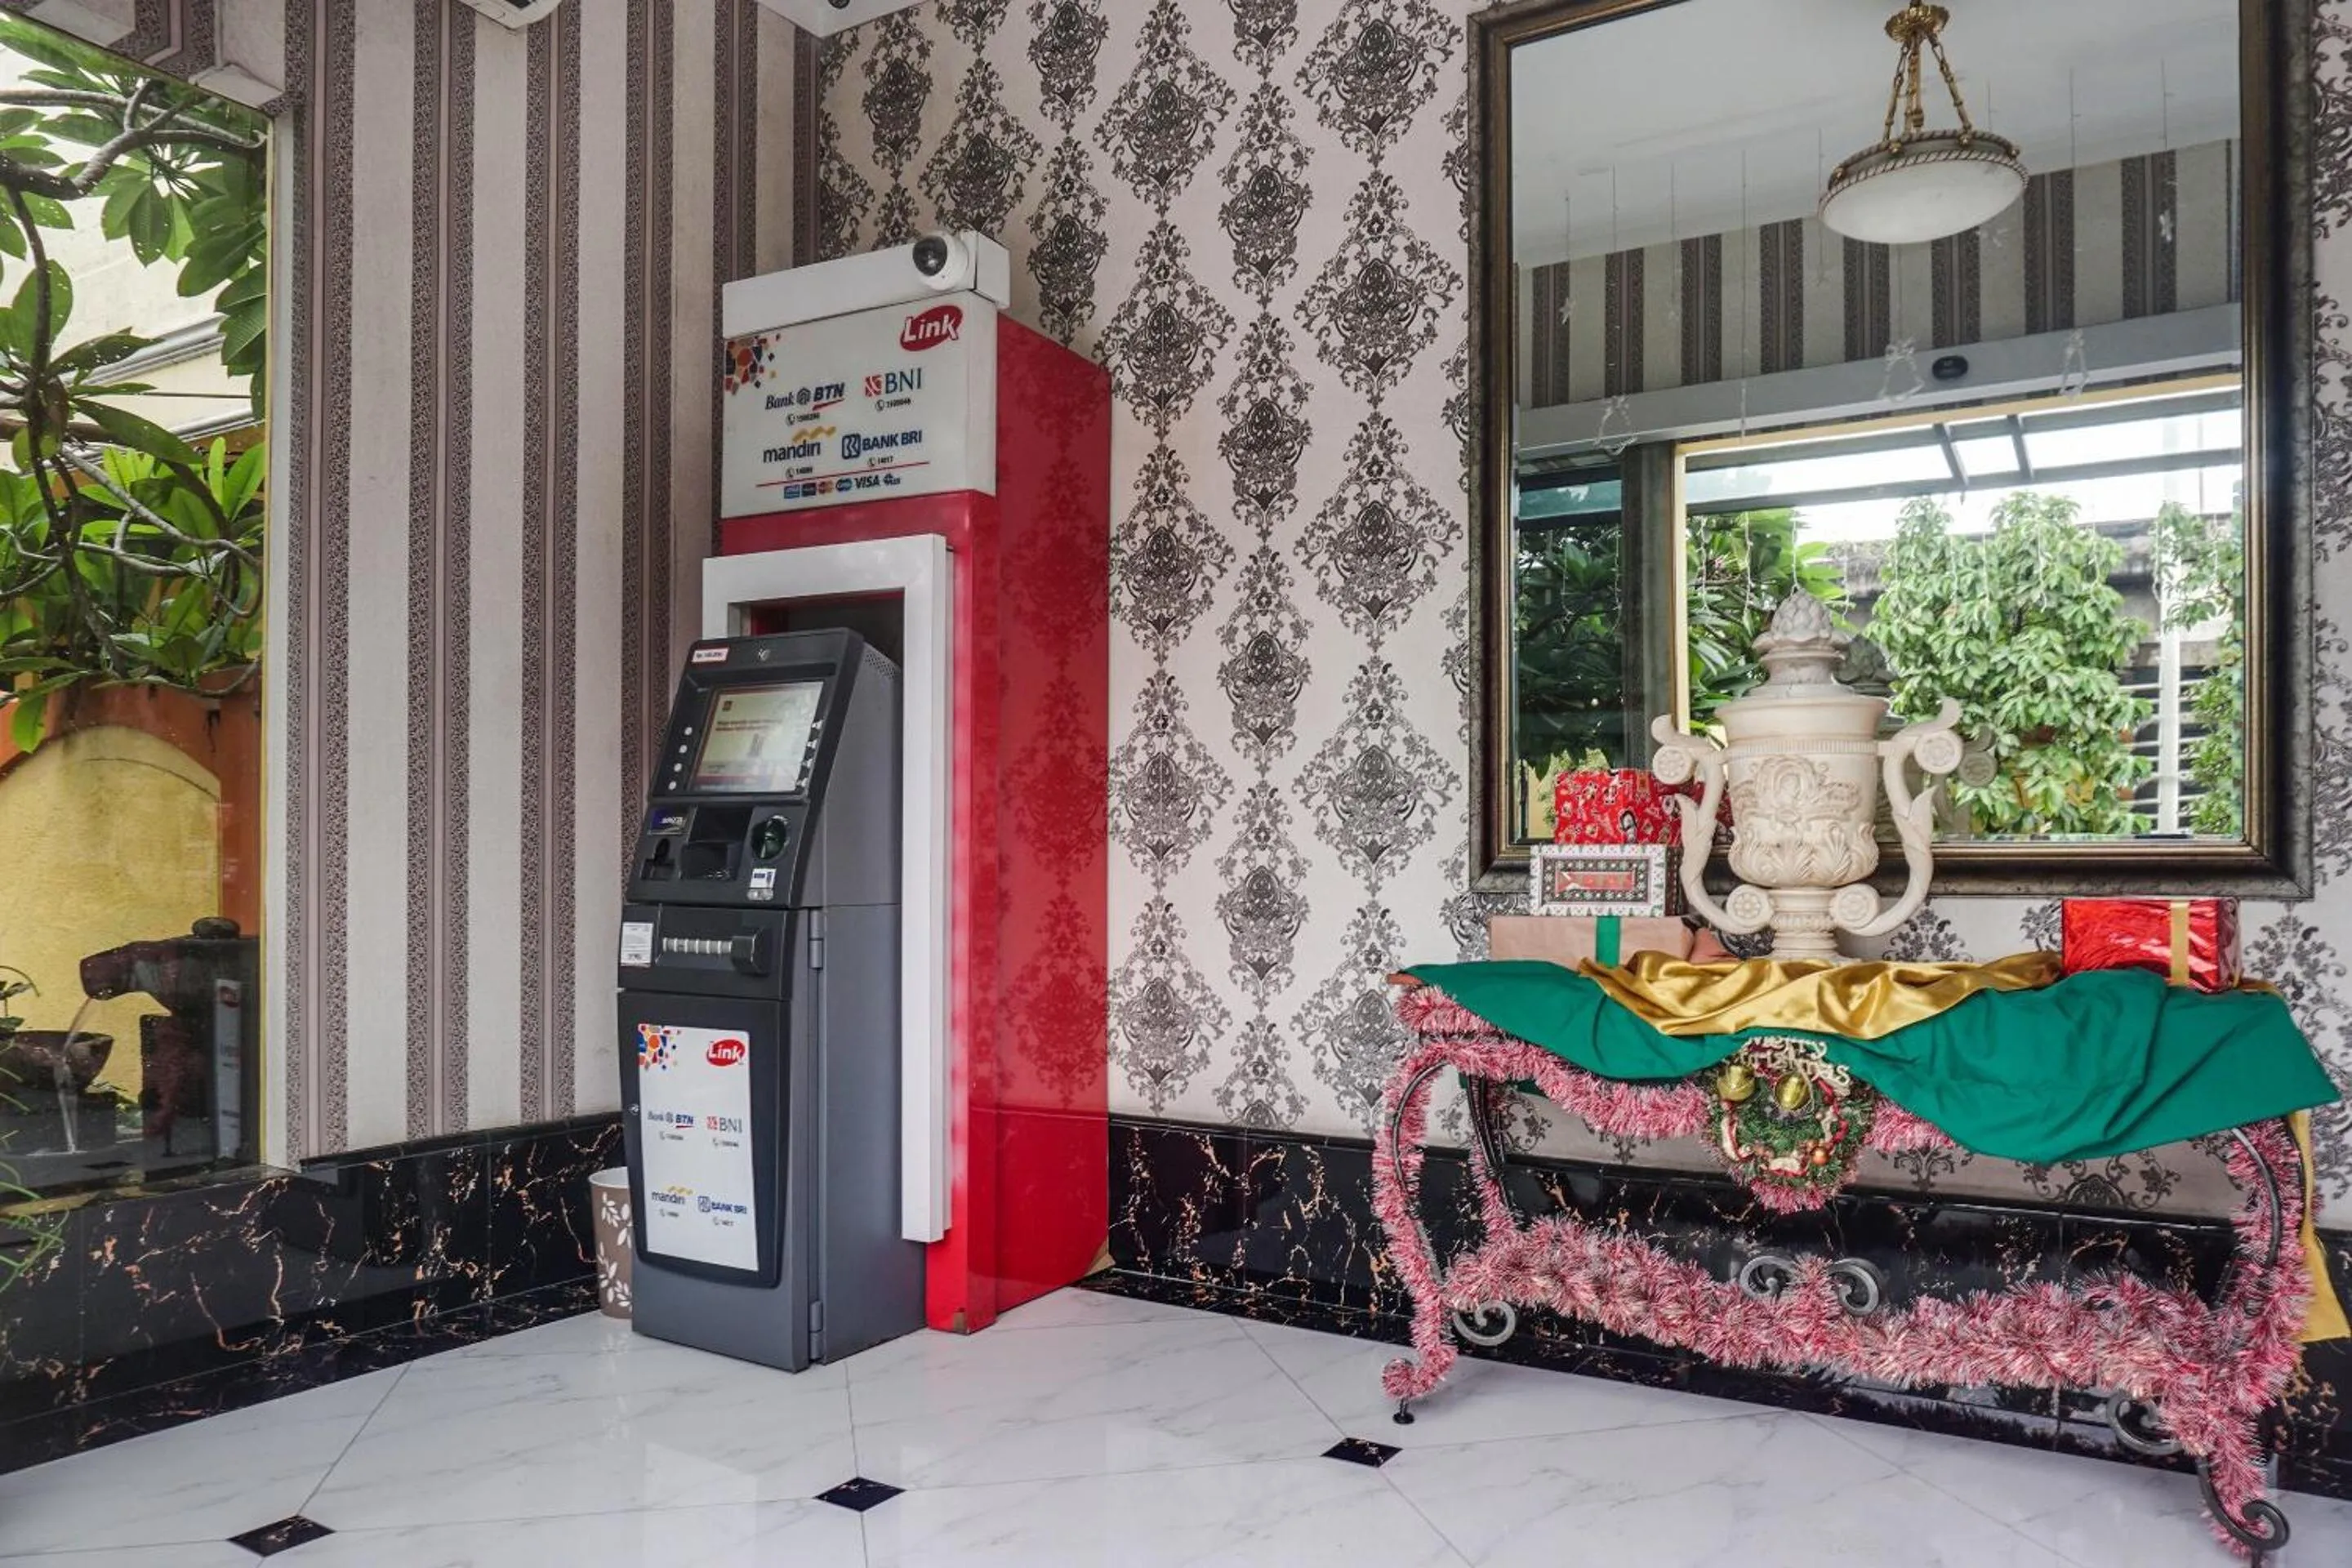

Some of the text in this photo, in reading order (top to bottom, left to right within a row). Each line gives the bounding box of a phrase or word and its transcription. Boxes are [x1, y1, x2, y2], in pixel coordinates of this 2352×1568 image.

[902, 314, 959, 342] Link
[885, 368, 921, 394] BNI
[765, 382, 845, 409] Bank BTN
[862, 430, 922, 451] BANK BRI
[854, 475, 880, 488] VISA
[708, 1042, 742, 1064] Link
[675, 1114, 693, 1125] BTN
[719, 1117, 742, 1134] BNI
